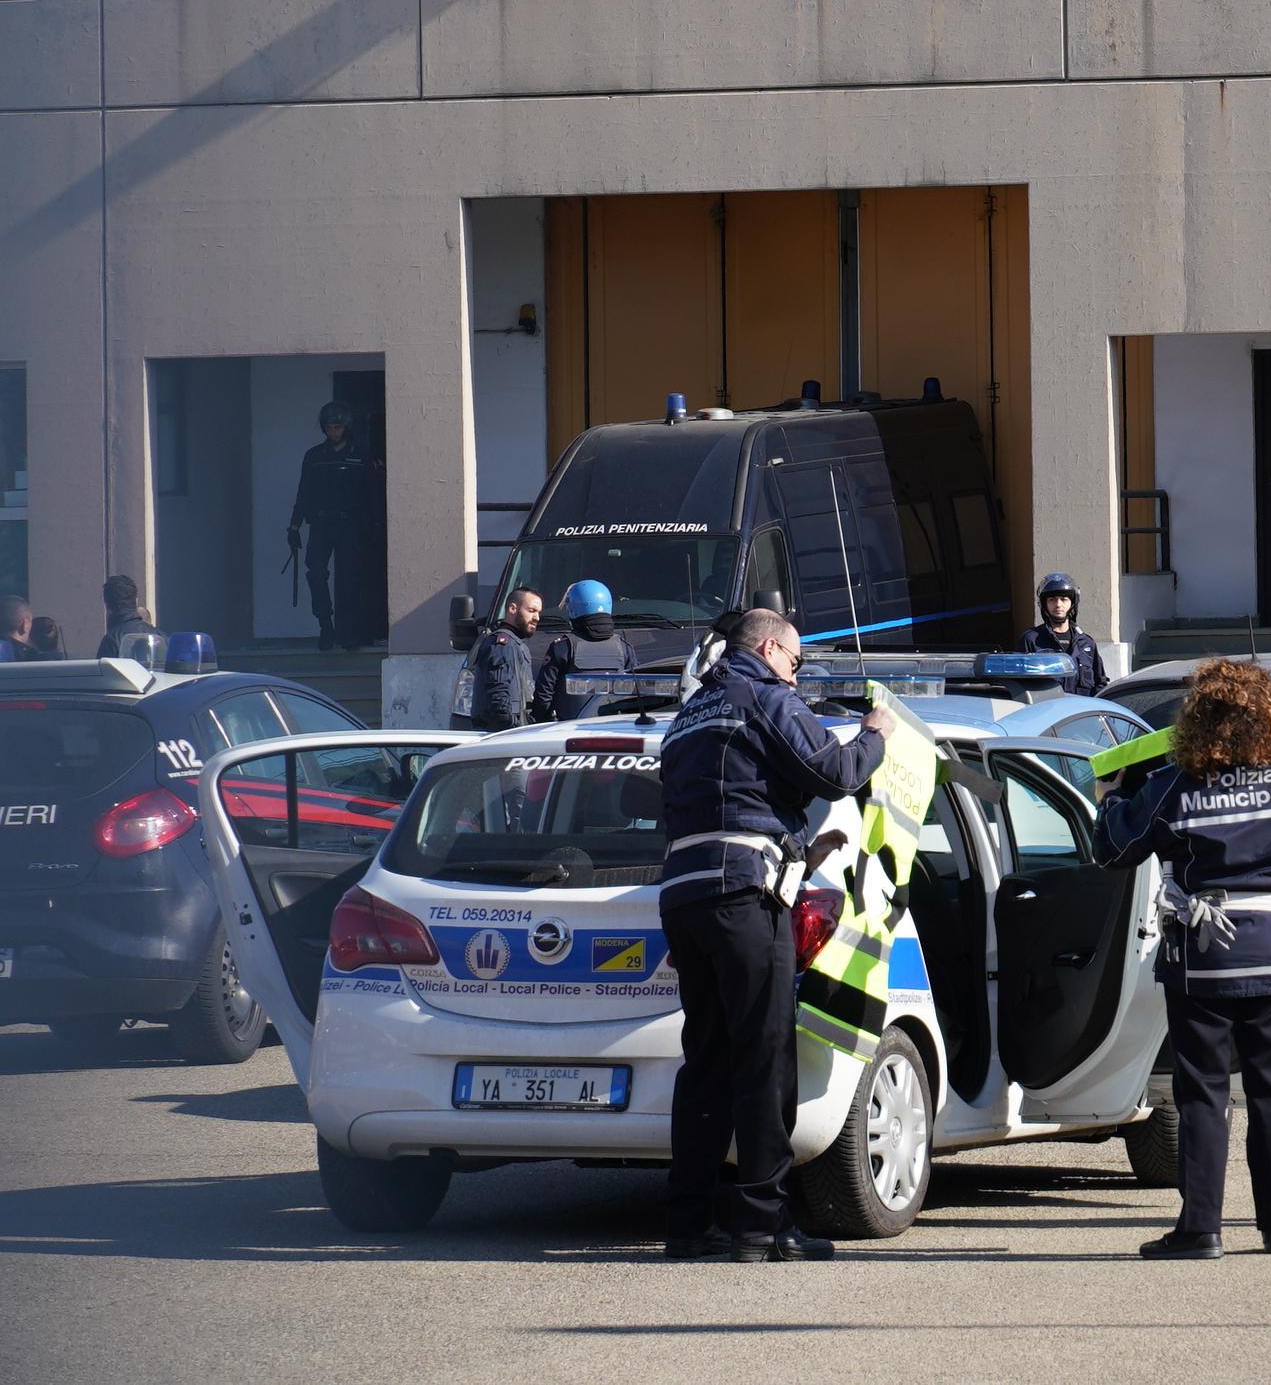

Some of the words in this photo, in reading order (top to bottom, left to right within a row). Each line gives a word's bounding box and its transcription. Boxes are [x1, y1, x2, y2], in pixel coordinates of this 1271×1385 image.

[555, 524, 605, 536] POLIZIA
[608, 523, 708, 534] PENITENZIARIA
[157, 738, 203, 769] 112
[504, 755, 598, 771] POLIZIA
[429, 906, 457, 920] TEL.
[462, 907, 533, 923] 059.20314
[594, 938, 630, 947] MODENA
[625, 955, 642, 968] 29
[353, 980, 392, 995] Police
[453, 981, 489, 993] Local
[500, 982, 536, 995] Local
[540, 983, 581, 995] Police
[595, 983, 679, 998] Stadtpolizei
[505, 1068, 539, 1079] POLIZIA
[544, 1069, 580, 1080] LOCALE
[482, 1079, 500, 1101] YA
[525, 1079, 554, 1101] 351
[578, 1080, 600, 1102] AL
